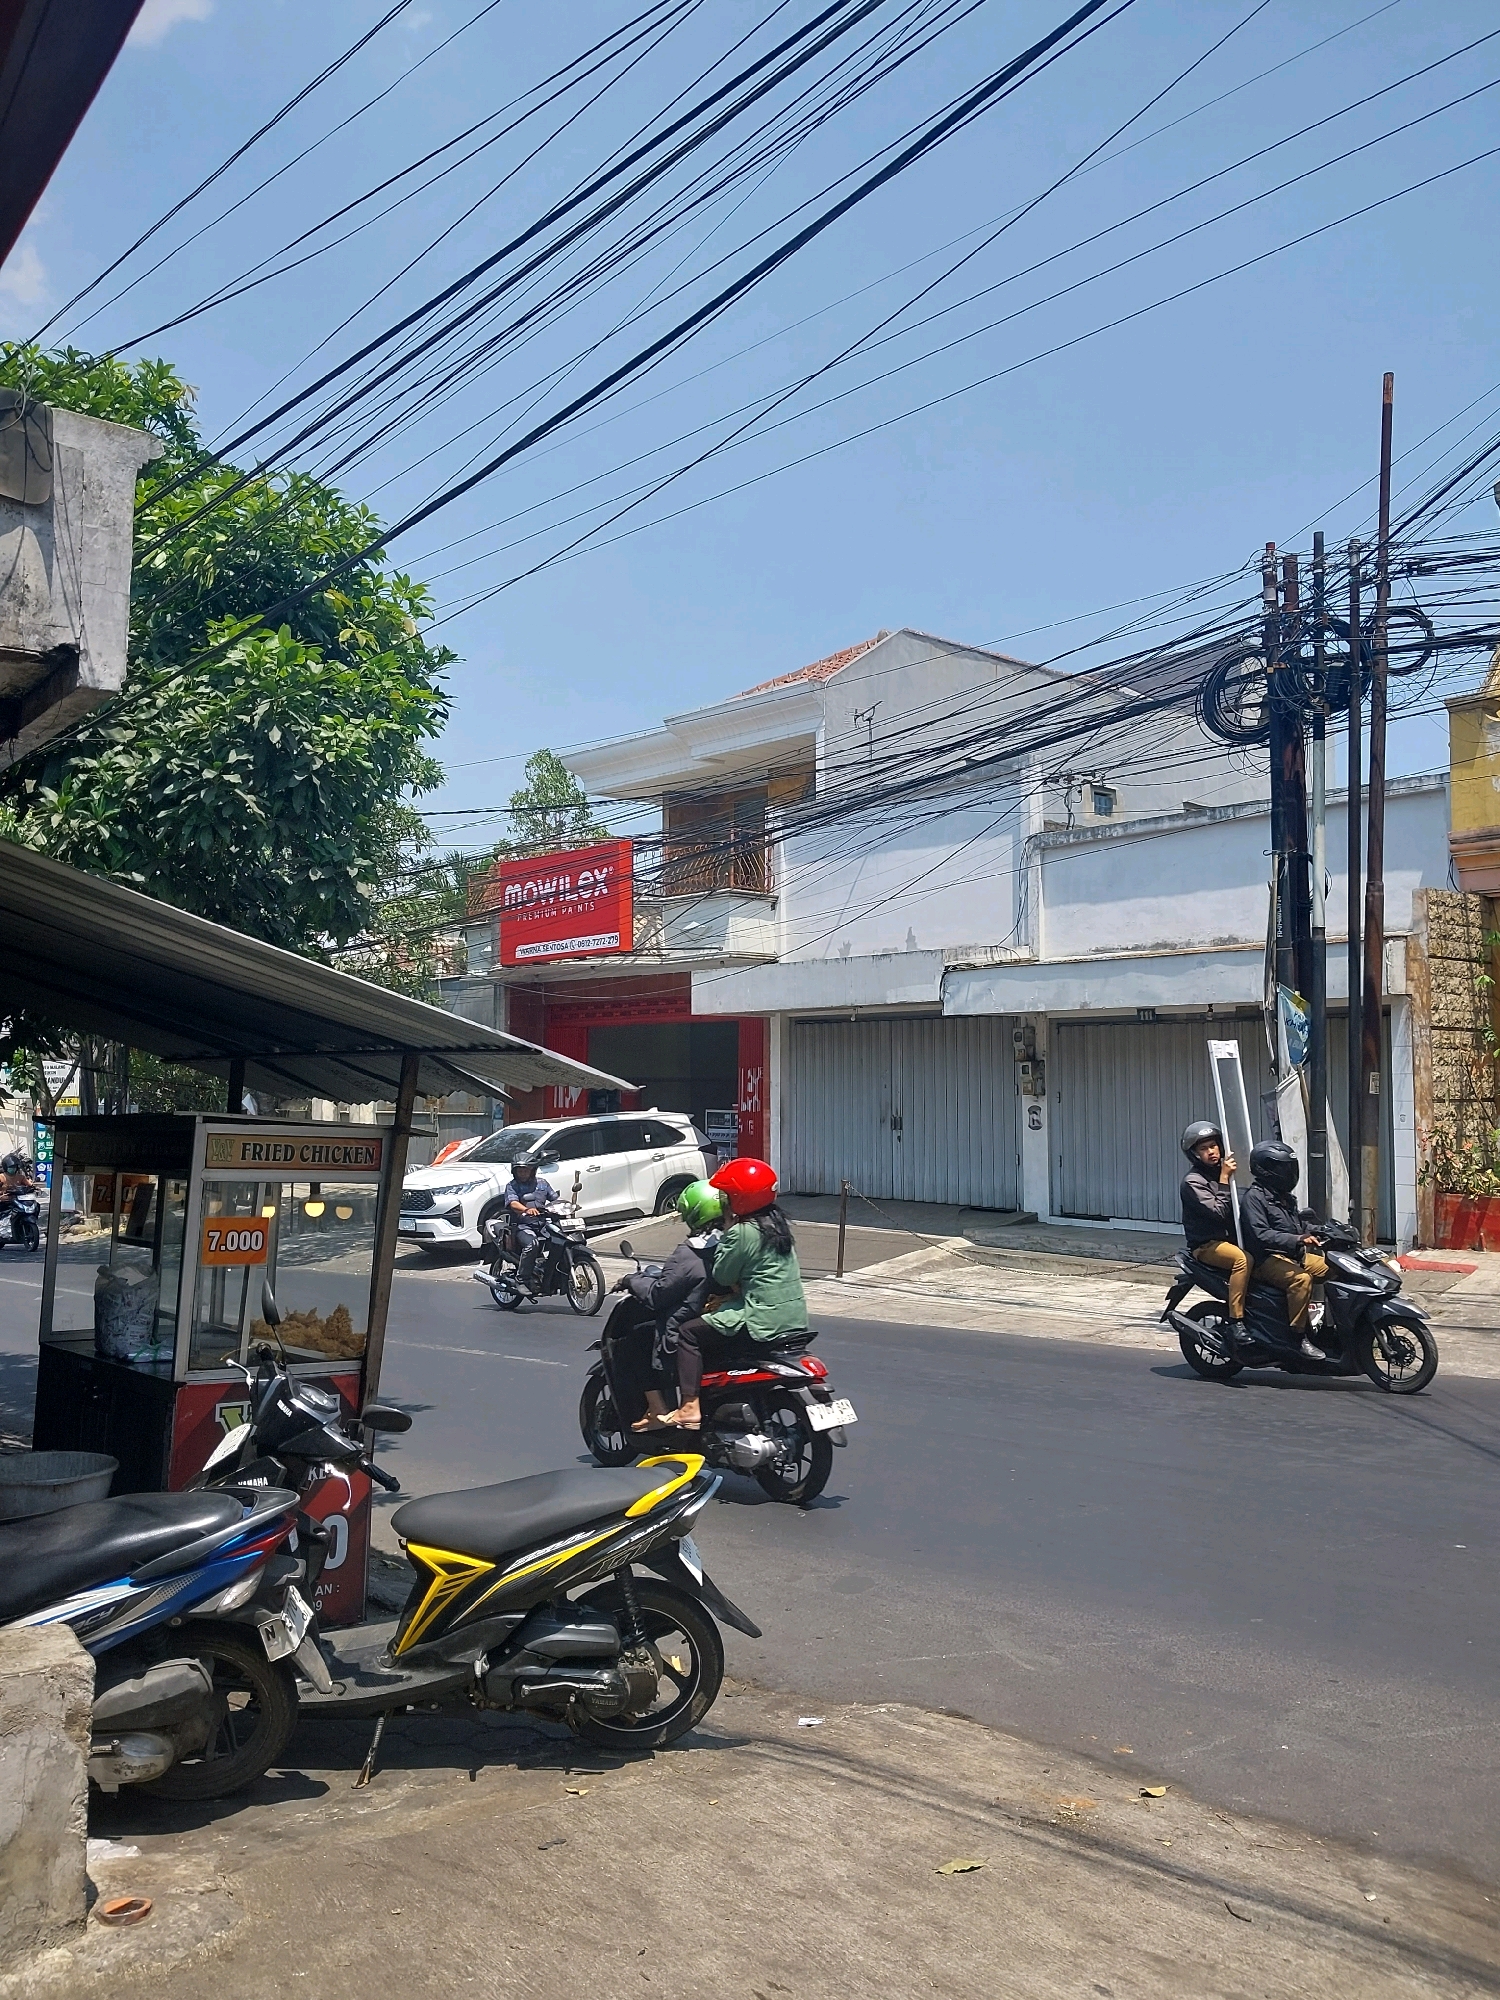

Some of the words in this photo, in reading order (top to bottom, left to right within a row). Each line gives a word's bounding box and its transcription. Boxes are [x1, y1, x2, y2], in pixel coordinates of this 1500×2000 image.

[240, 1142, 296, 1163] FRIED
[299, 1144, 376, 1166] CHICKEN
[207, 1230, 264, 1252] 7.000
[314, 1583, 333, 1597] AN
